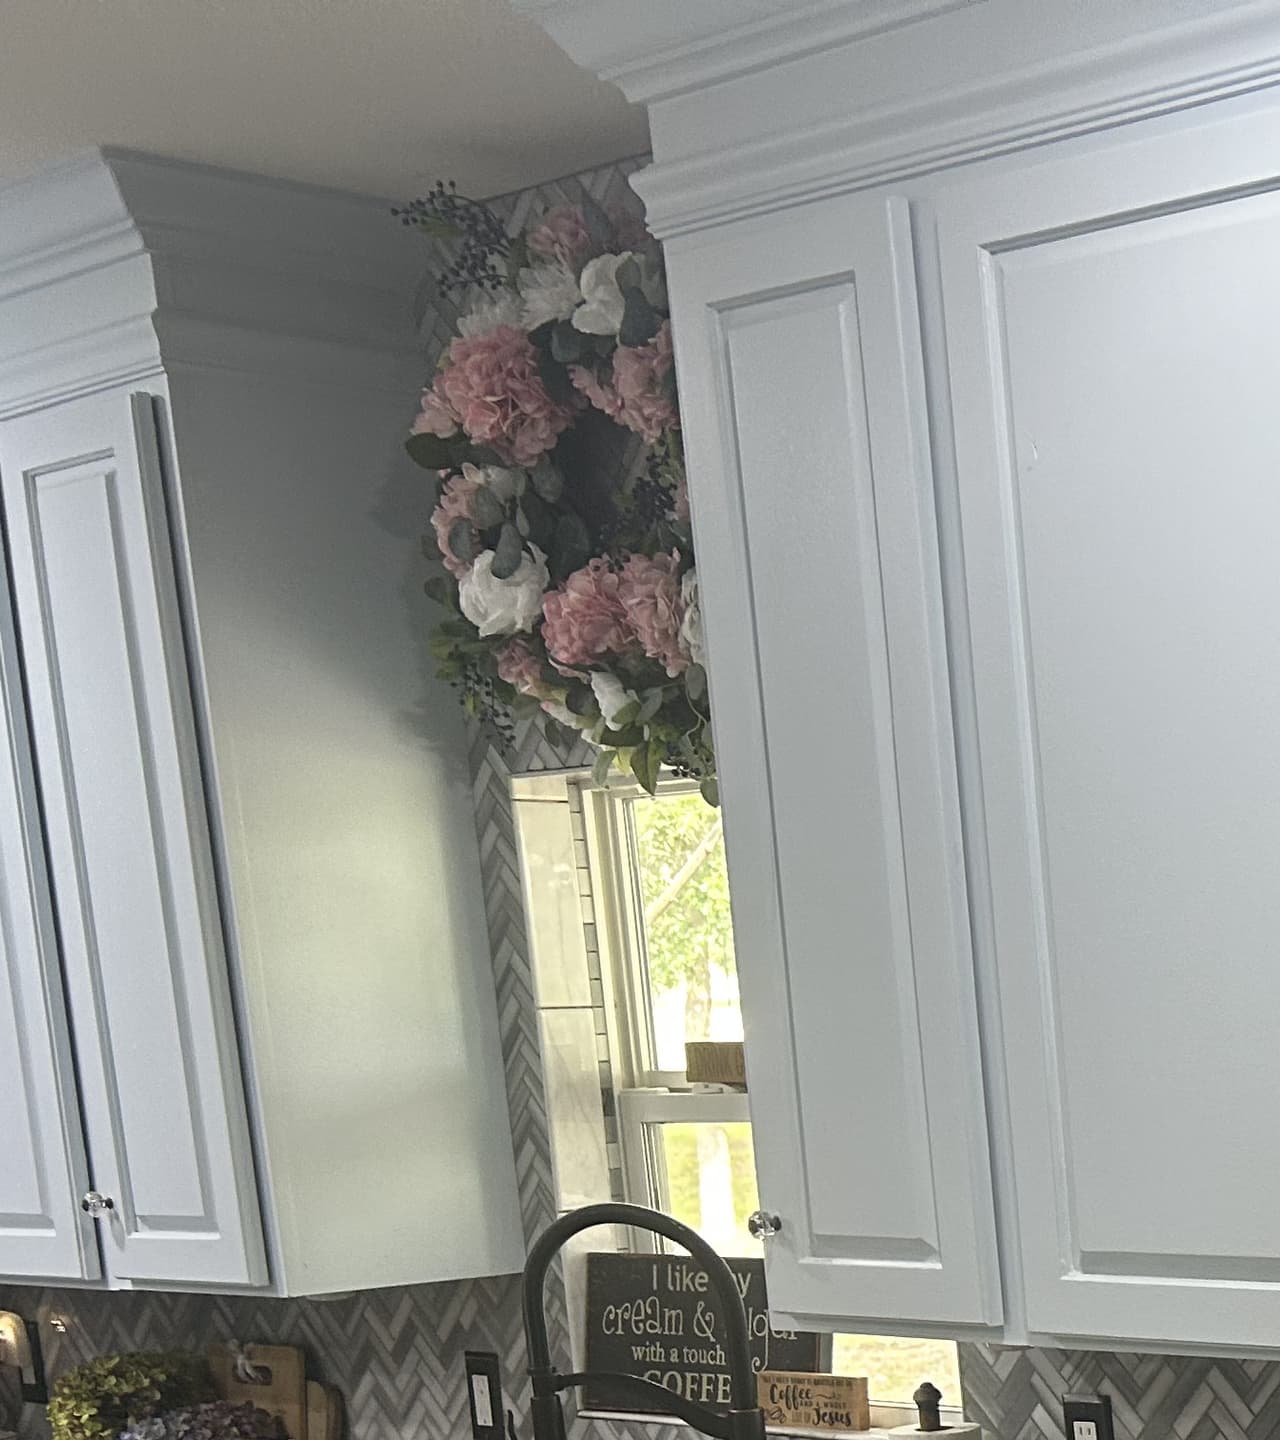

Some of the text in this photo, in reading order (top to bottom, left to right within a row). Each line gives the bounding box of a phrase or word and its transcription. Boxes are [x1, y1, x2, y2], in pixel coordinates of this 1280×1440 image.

[653, 1264, 658, 1291] I
[667, 1265, 709, 1292] like
[602, 1296, 684, 1336] cream
[693, 1301, 716, 1342] &
[631, 1341, 727, 1366] with a touch
[643, 1370, 732, 1404] OFFE
[769, 1383, 813, 1411] Coffee
[812, 1407, 852, 1427] Jesus
